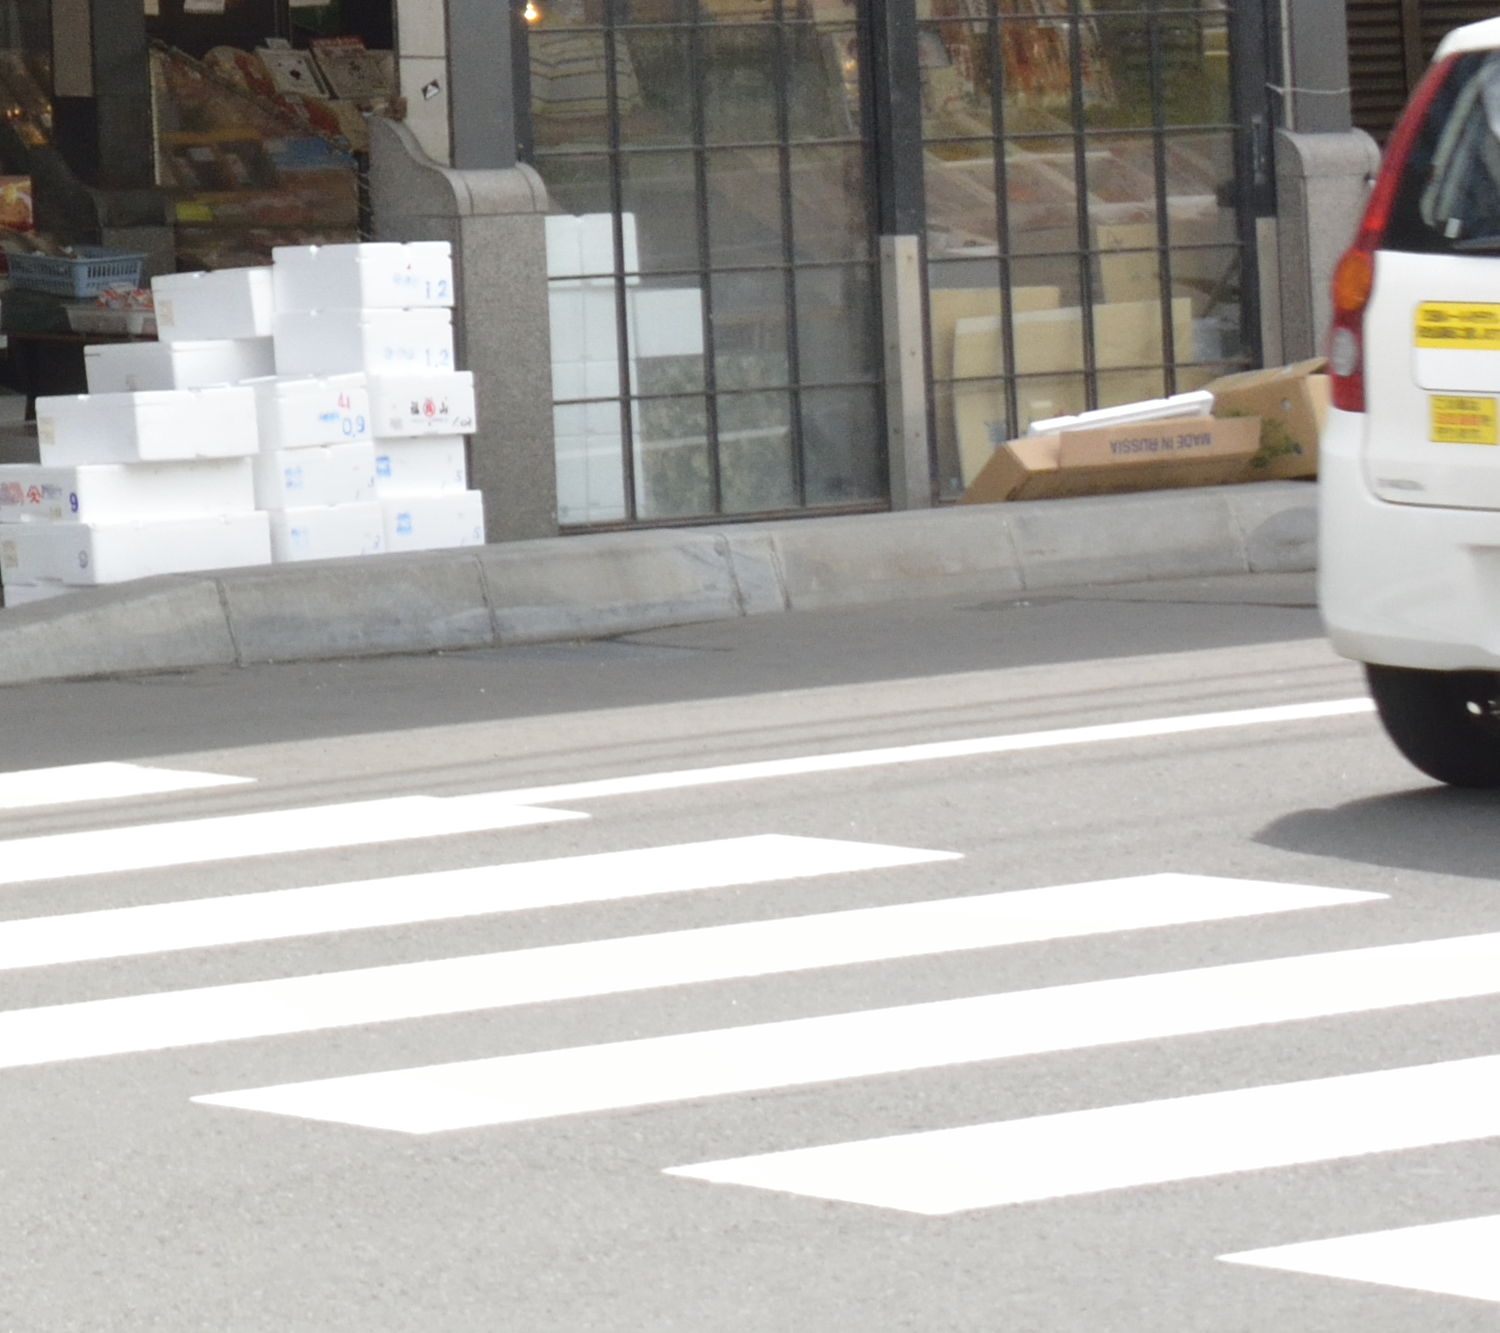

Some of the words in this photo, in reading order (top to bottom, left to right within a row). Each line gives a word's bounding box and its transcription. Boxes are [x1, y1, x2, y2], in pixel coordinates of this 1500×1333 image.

[1109, 437, 1159, 455] RUSSIA
[1160, 435, 1174, 450] IN
[1176, 432, 1214, 448] MADE
